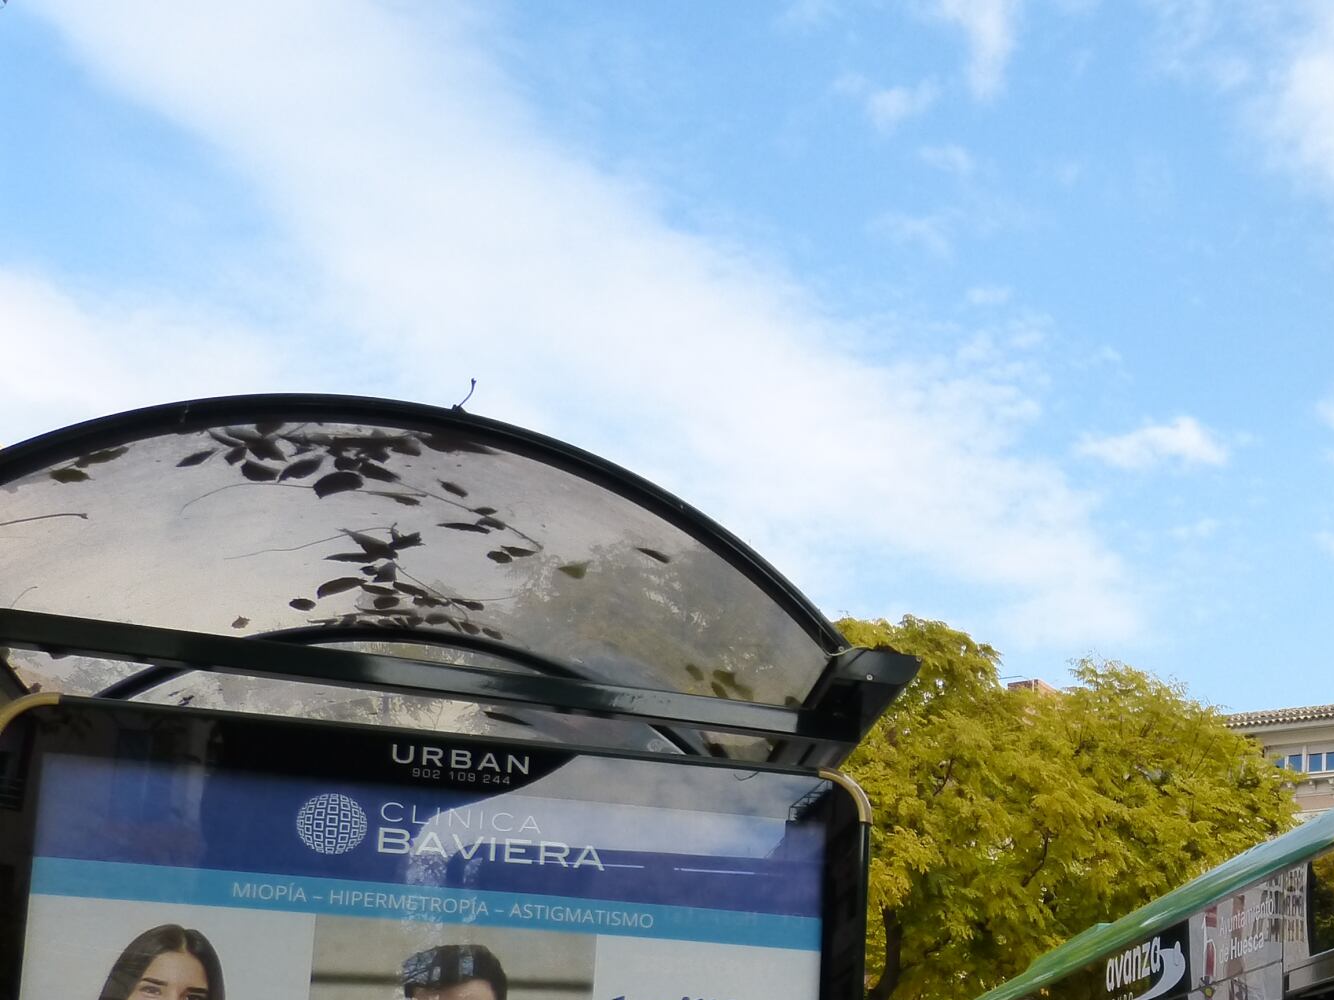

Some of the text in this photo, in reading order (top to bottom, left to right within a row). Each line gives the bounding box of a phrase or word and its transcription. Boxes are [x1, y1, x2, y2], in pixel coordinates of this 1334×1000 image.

[391, 743, 530, 775] URBAN
[412, 767, 511, 785] 902 109 244
[381, 802, 542, 835] CLINICA
[377, 827, 605, 872] BAVIERA
[232, 881, 307, 904] MIOPÍA
[329, 890, 489, 916] HIPERMETROPÍA
[508, 904, 655, 930] ASTIGMATISMO
[1105, 936, 1161, 993] avanza
[1218, 930, 1265, 965] de Huesca
